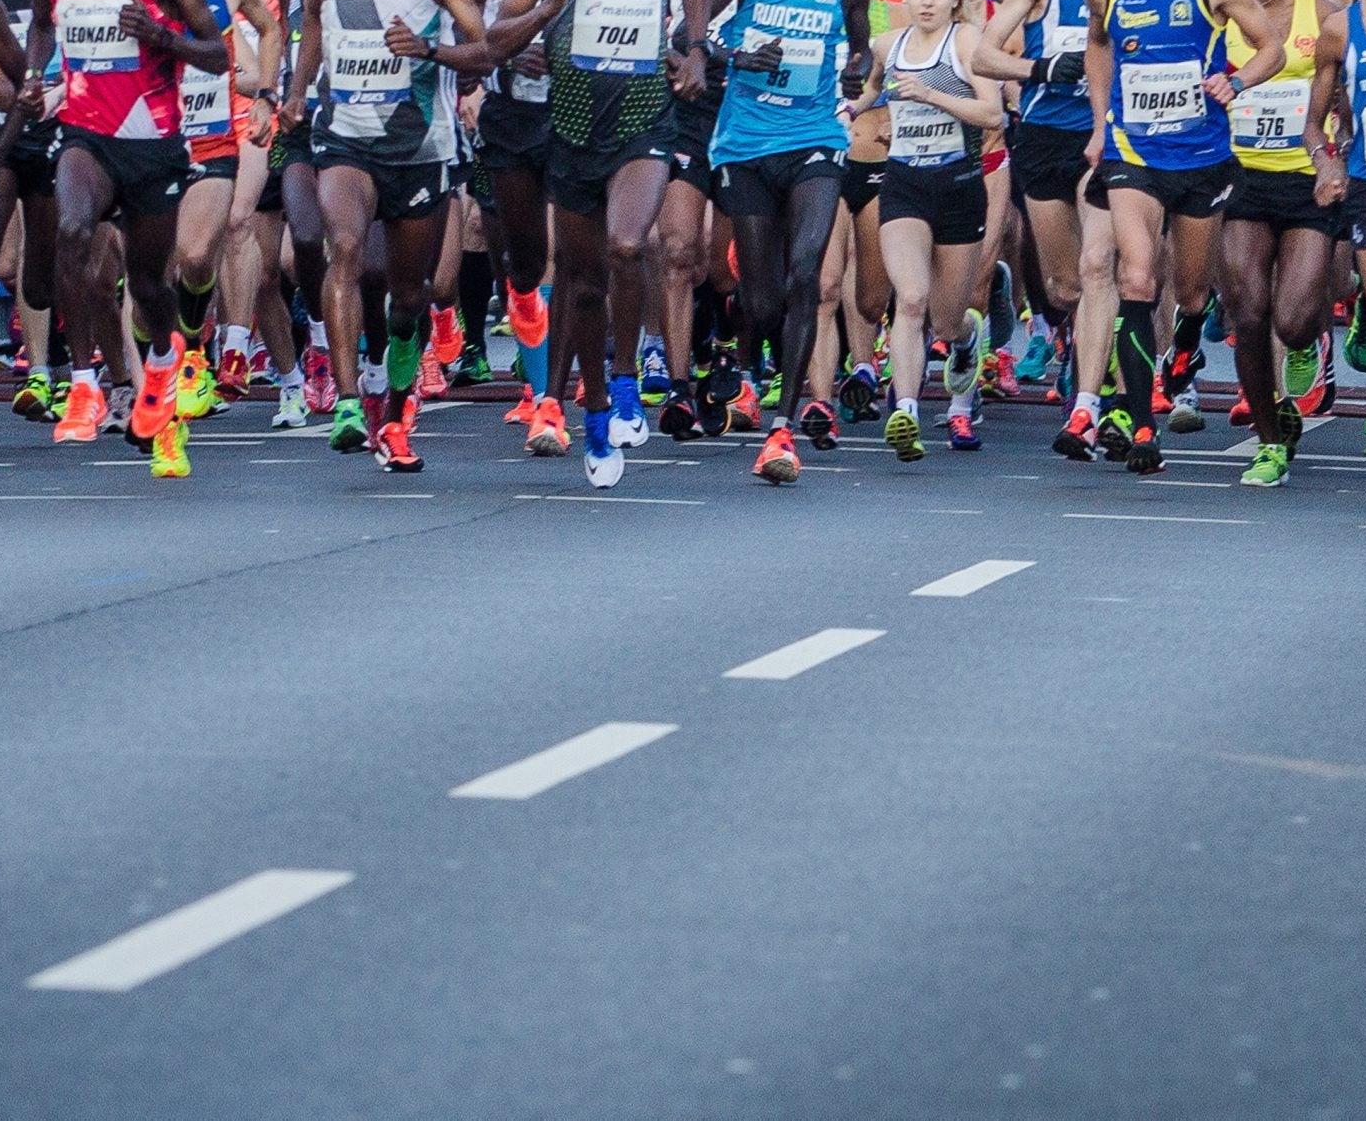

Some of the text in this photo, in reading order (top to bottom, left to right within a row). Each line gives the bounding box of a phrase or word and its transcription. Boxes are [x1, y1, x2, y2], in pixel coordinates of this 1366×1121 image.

[596, 25, 640, 46] TOLA
[335, 57, 404, 76] BIRHANU
[184, 91, 218, 112] RON
[1130, 89, 1189, 110] TOBIAS
[896, 121, 956, 139] CHARLOTTE
[1255, 116, 1286, 137] 576
